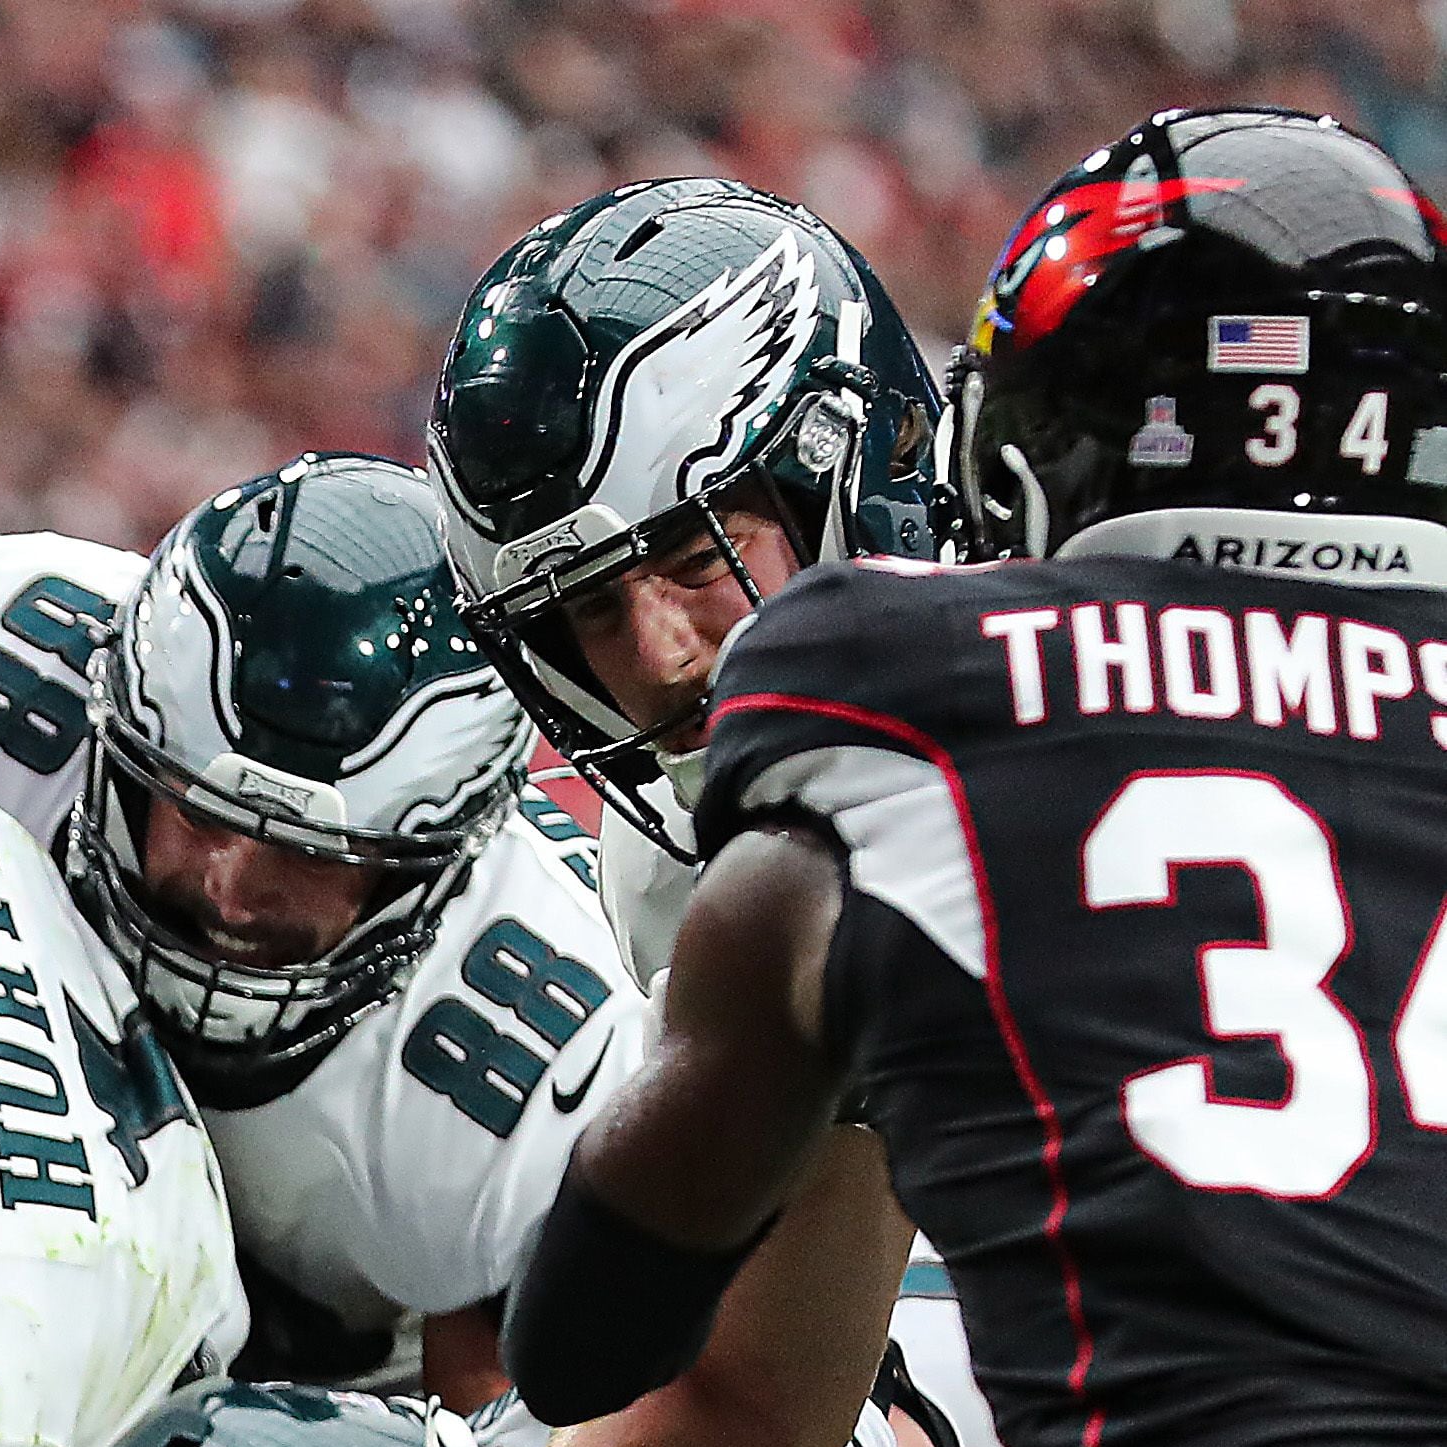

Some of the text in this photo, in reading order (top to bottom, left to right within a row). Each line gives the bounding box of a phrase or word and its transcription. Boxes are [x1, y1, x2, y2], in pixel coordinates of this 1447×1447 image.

[1170, 532, 1411, 573] ARIZONA
[401, 917, 613, 1140] 88
[1077, 766, 1447, 1202] 3
